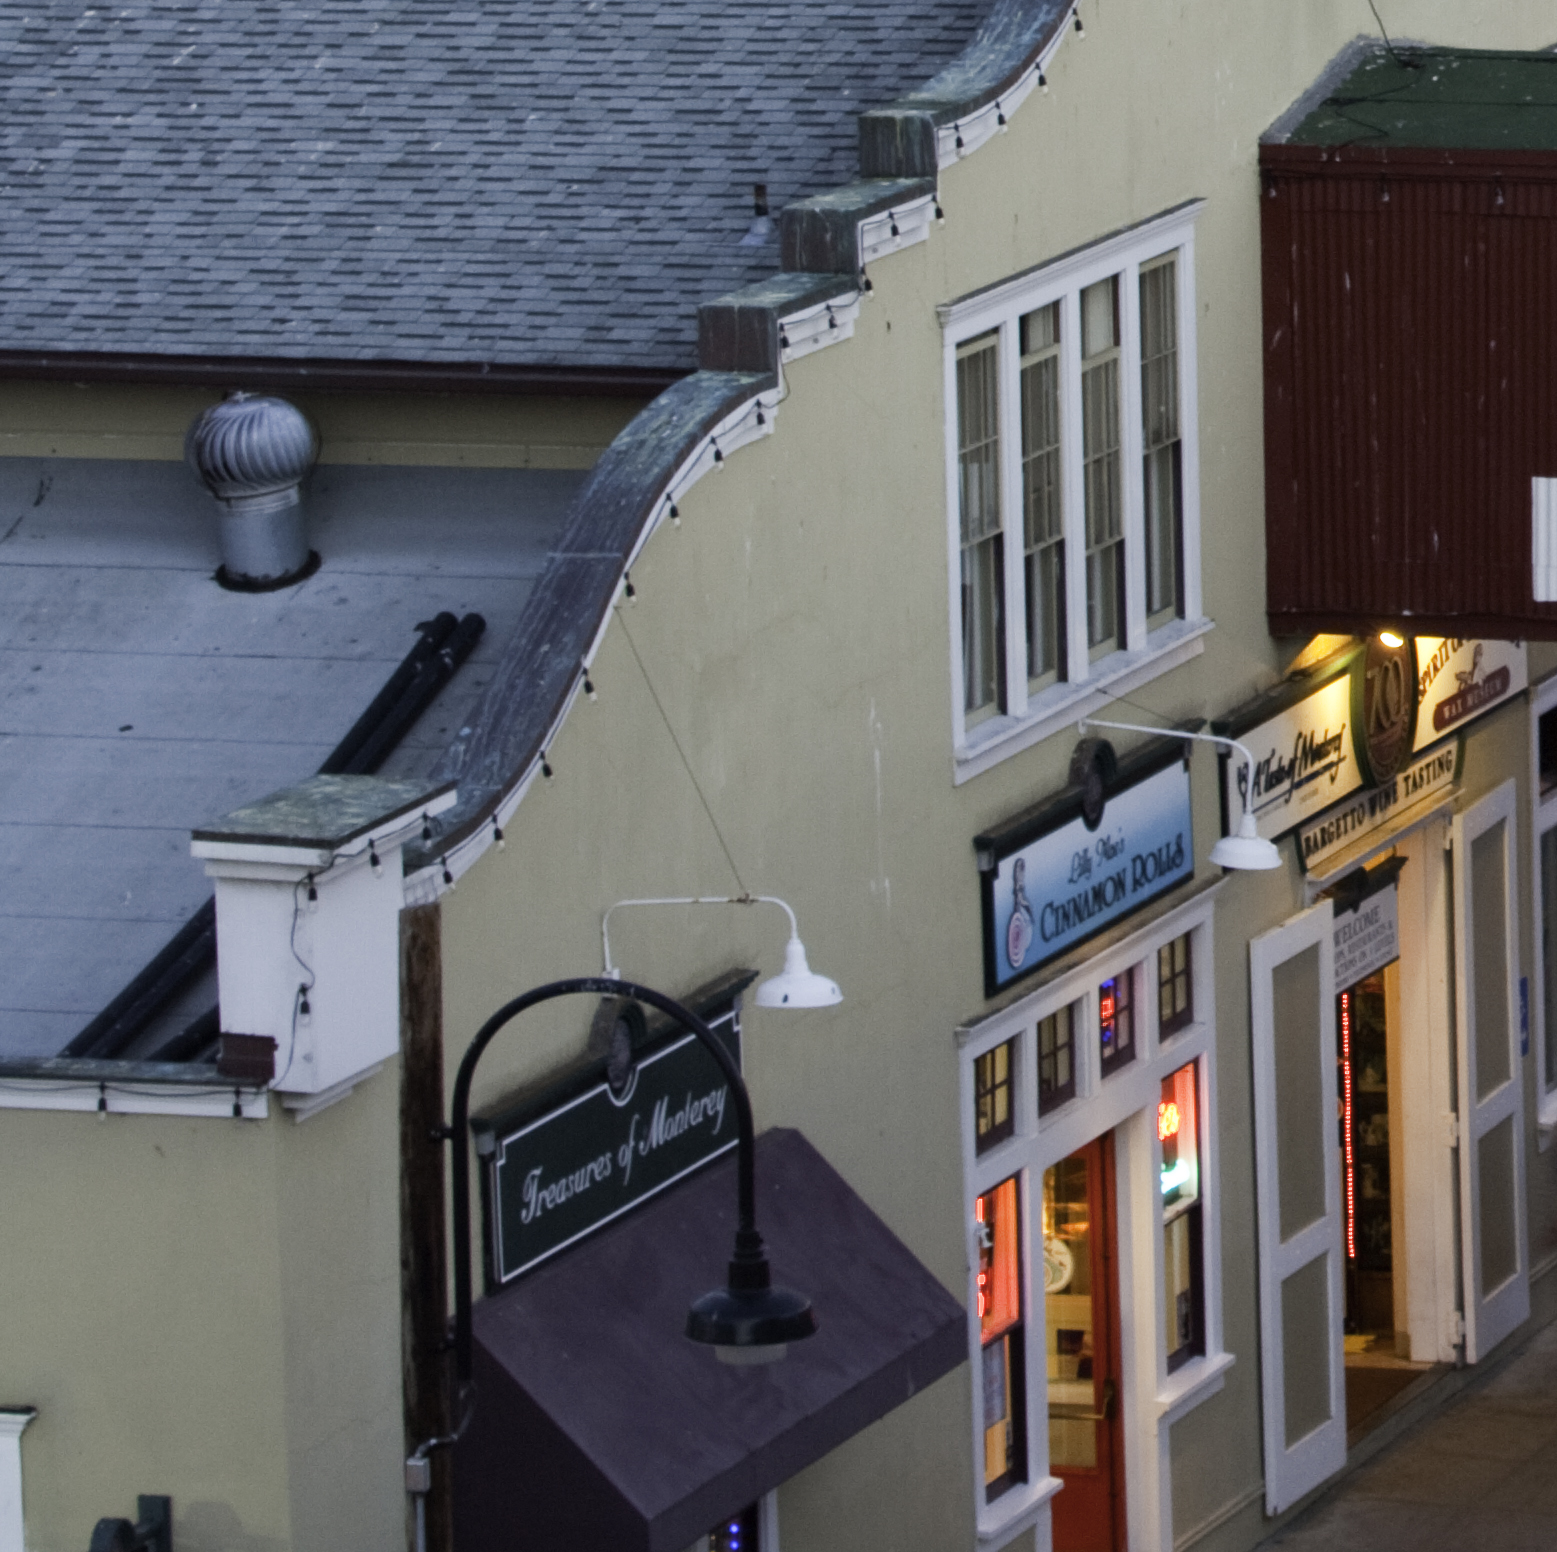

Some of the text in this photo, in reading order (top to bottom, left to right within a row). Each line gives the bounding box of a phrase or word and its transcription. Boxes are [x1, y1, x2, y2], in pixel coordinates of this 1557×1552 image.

[1443, 699, 1463, 719] WAX
[1303, 806, 1366, 857] BARGETTO
[1368, 777, 1397, 816] WINE
[1403, 750, 1453, 796] TASTING
[1040, 832, 1184, 943] CINNAMON ROLLS
[520, 1085, 728, 1224] Treasures of Monterey
